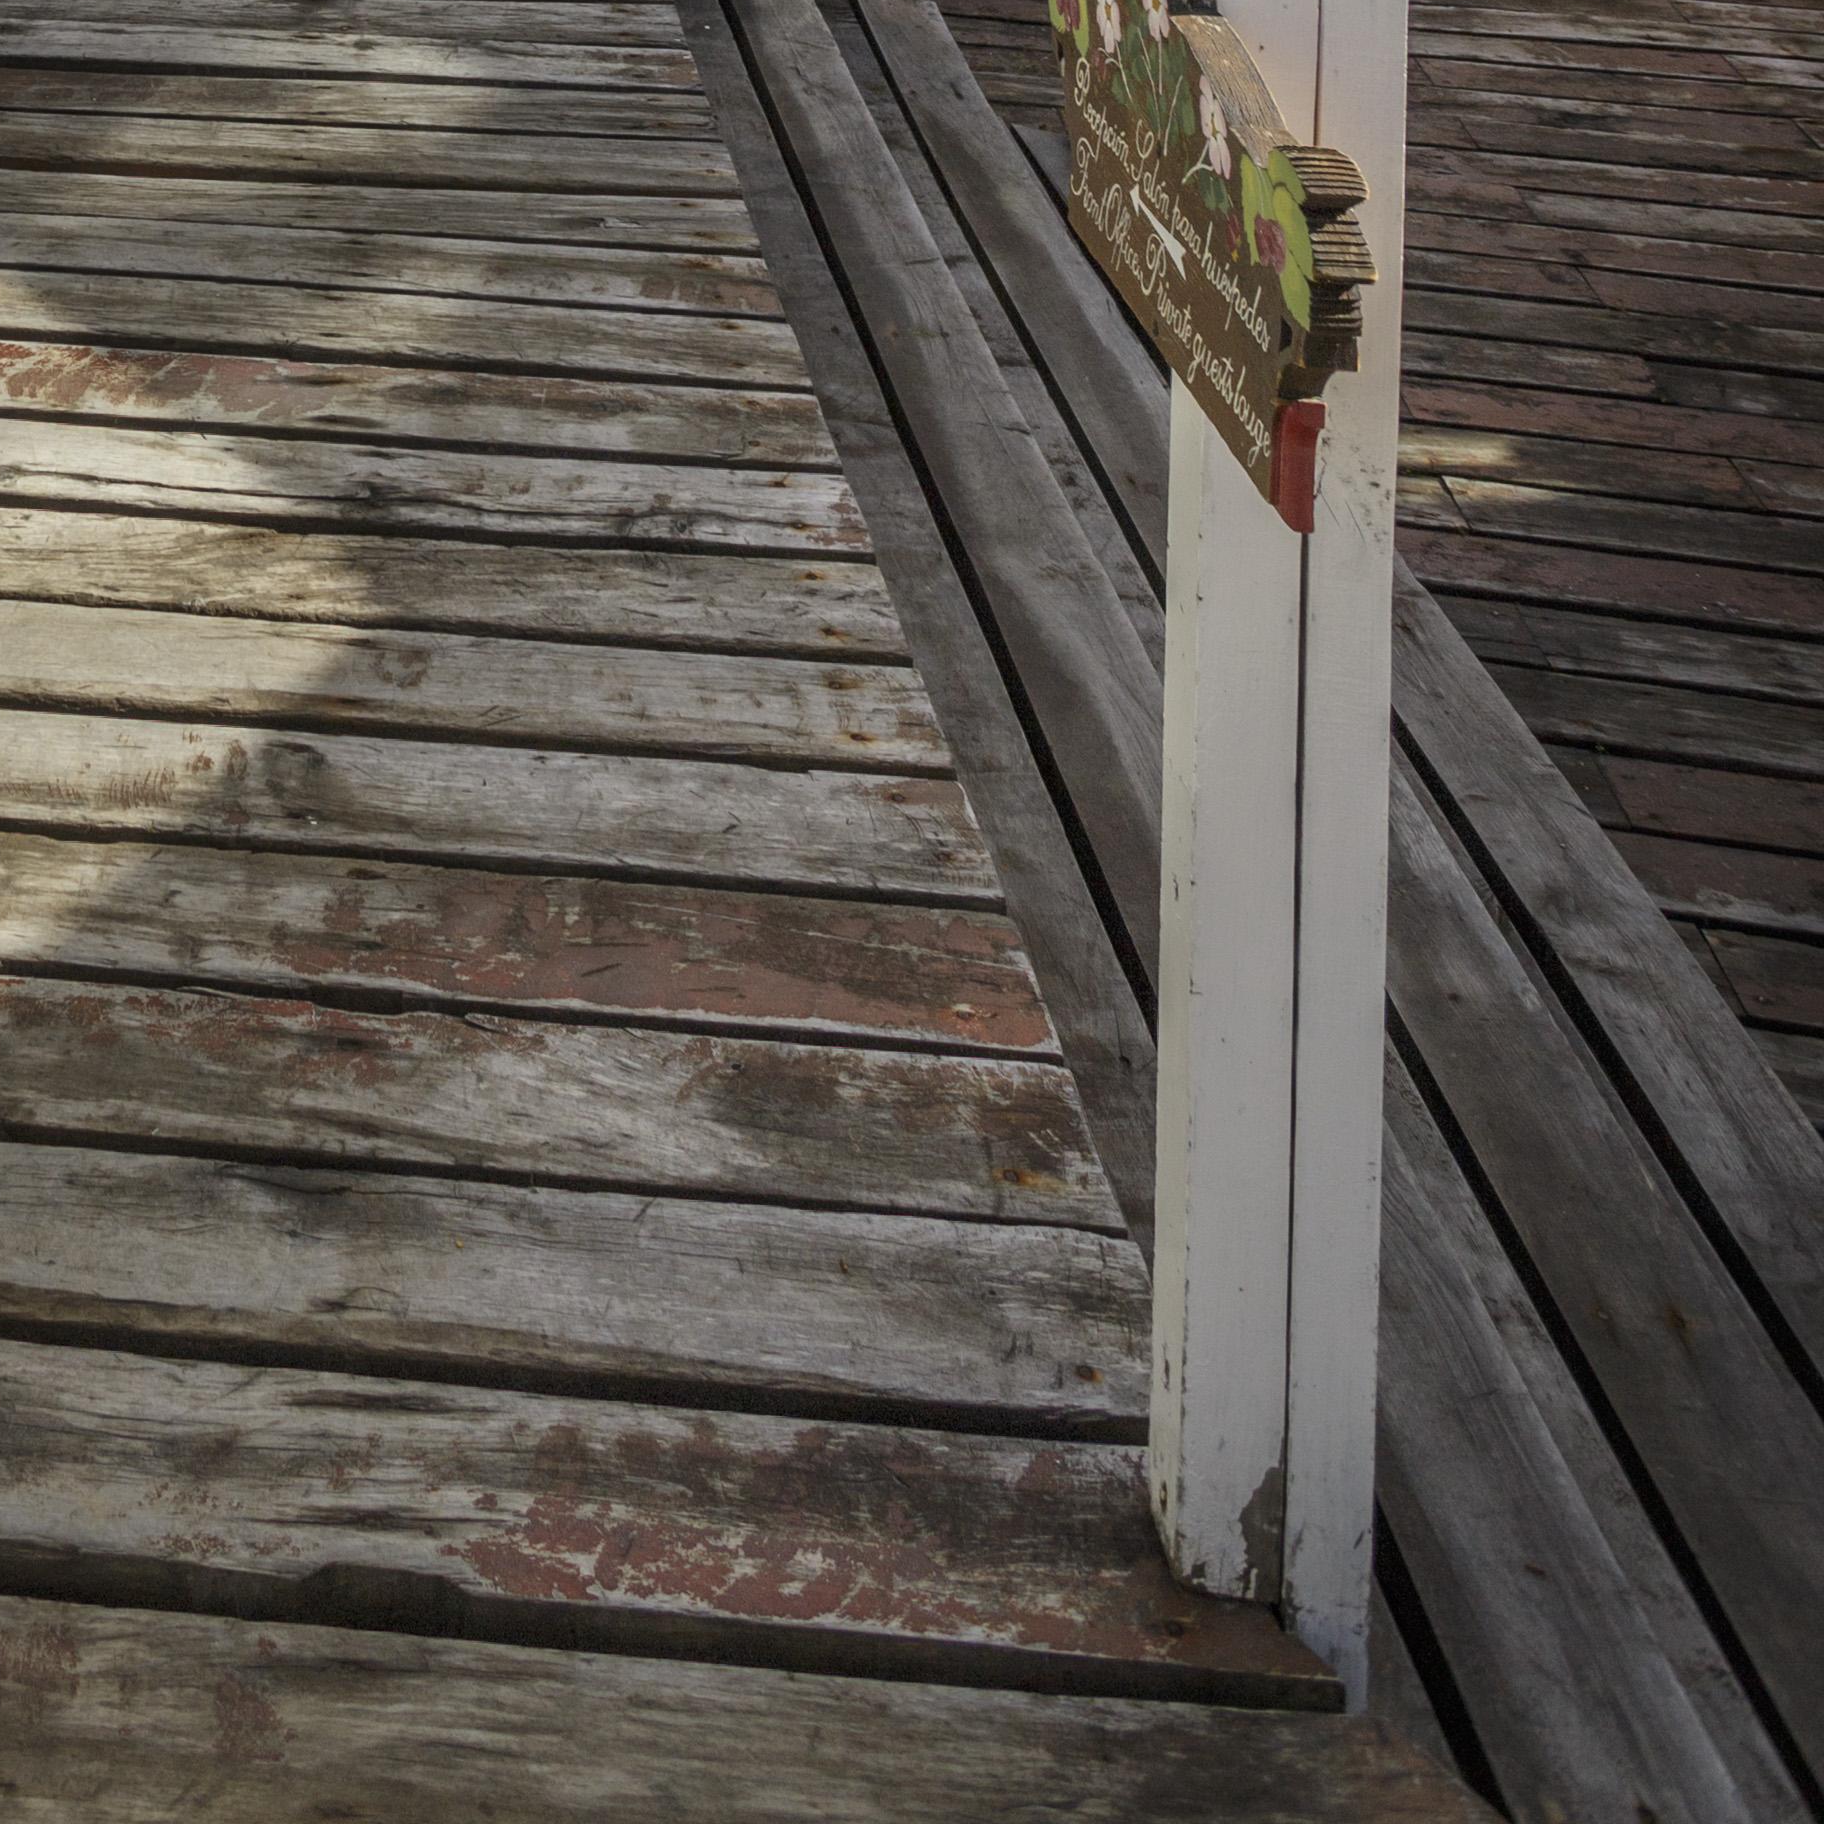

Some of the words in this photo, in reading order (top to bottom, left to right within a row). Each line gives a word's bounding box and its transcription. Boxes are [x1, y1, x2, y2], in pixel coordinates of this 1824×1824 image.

[1071, 137, 1108, 232] Front
[1140, 233, 1192, 350] Private
[1186, 333, 1234, 405] guests
[1131, 119, 1169, 220] Salón
[1171, 194, 1201, 259] para
[1201, 221, 1270, 352] huéspedes
